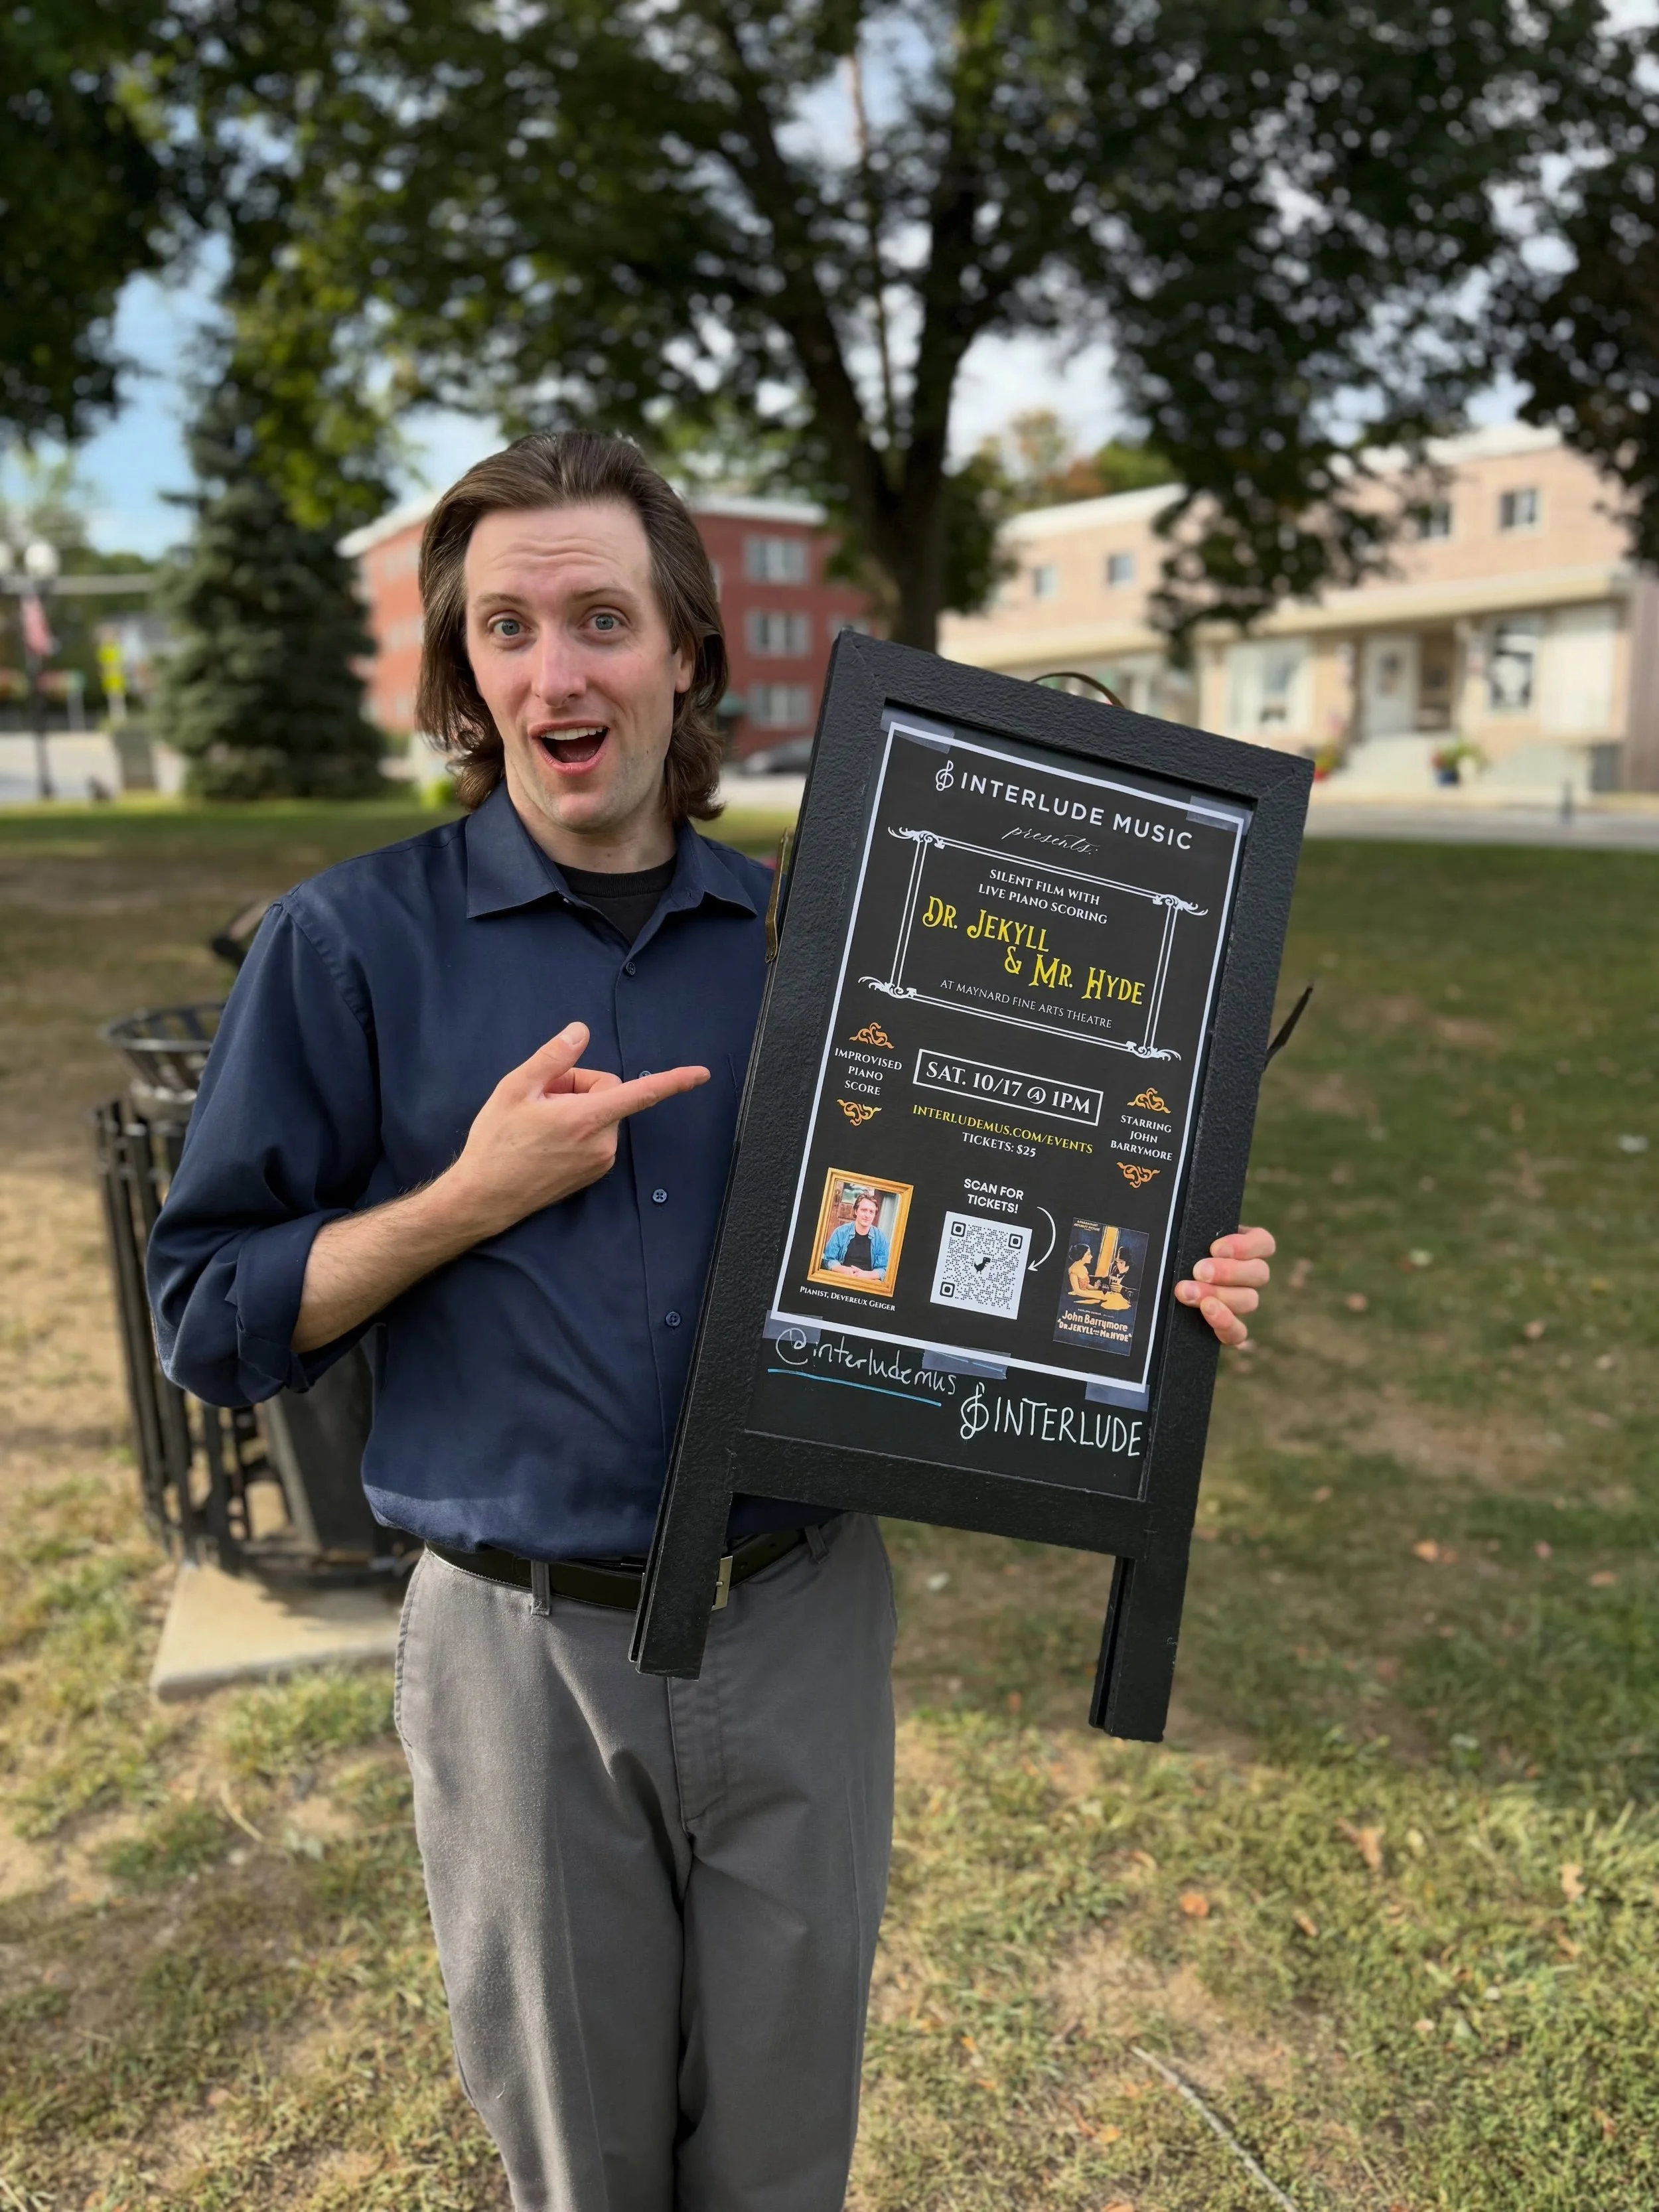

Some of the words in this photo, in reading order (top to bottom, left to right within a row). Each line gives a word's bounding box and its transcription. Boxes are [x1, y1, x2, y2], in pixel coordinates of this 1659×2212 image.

[961, 772, 1104, 826] INTERLUDE
[1112, 813, 1193, 850] MUSIC
[1001, 826, 1102, 855] presents:
[989, 869, 1033, 888] SILENT
[1035, 881, 1064, 896] FILM
[1068, 889, 1100, 905] WITH
[978, 883, 1005, 899] LIVE
[1008, 891, 1048, 910] PIANO
[1050, 902, 1108, 924] SCORING
[1004, 946, 1022, 975] &
[940, 980, 954, 990] AT
[956, 983, 1010, 1003] MAYNARD
[1012, 997, 1036, 1010] FINE
[1039, 1003, 1064, 1017] ARTS
[1066, 1009, 1112, 1029] THEATRE
[834, 1048, 902, 1070] IMPROVISED
[848, 1065, 883, 1081] PIANO
[844, 1080, 881, 1096] SCORE
[926, 1061, 966, 1085] SAT.
[972, 1072, 1023, 1097] 10/17
[1027, 1086, 1046, 1104] @
[1051, 1091, 1090, 1114] 1PM
[912, 1104, 1094, 1153] INTERLUDEMUS.COM/EVENTS
[1120, 1114, 1172, 1133] STARRING
[1129, 1130, 1158, 1143] JOHN
[962, 1132, 1015, 1153] TICKETS:
[1016, 1144, 1037, 1157] $25
[1110, 1140, 1173, 1161] BARRYMORE
[964, 1178, 997, 1195] SCAN
[999, 1186, 1024, 1201] FOR
[967, 1193, 1019, 1214] TICKETS!
[1062, 1309, 1083, 1323] John
[1084, 1314, 1128, 1332] Barrymore
[775, 1327, 957, 1395] @interludemus
[994, 1396, 1143, 1457] INTERLUDE
